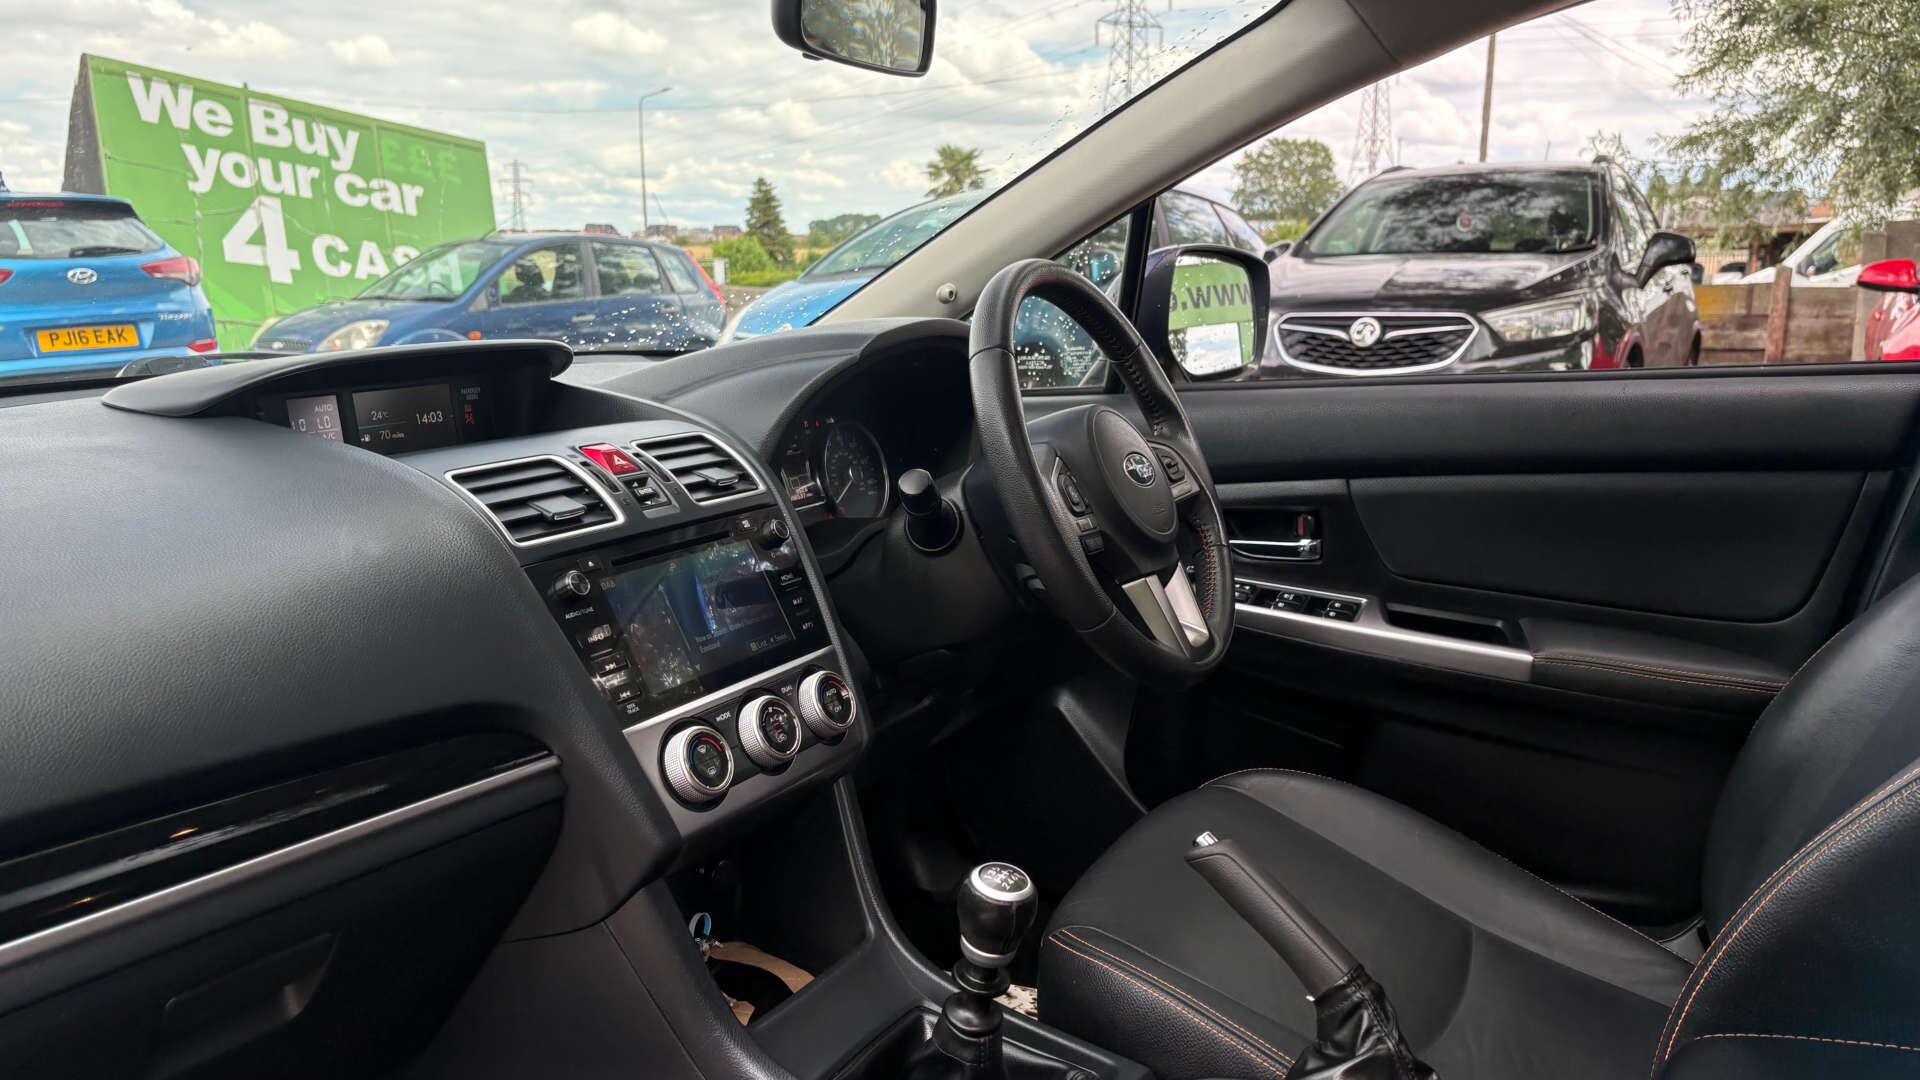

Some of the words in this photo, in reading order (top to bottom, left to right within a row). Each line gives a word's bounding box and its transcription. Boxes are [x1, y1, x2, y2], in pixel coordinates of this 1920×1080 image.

[126, 71, 234, 138] We
[248, 98, 360, 171] Buy
[181, 143, 320, 198] your
[334, 173, 424, 216] car
[222, 195, 300, 284] 4
[48, 329, 90, 347] PJ16
[95, 328, 129, 344] EAK
[415, 410, 443, 425] 14:03
[379, 430, 391, 440] 70
[715, 710, 732, 722] MODE
